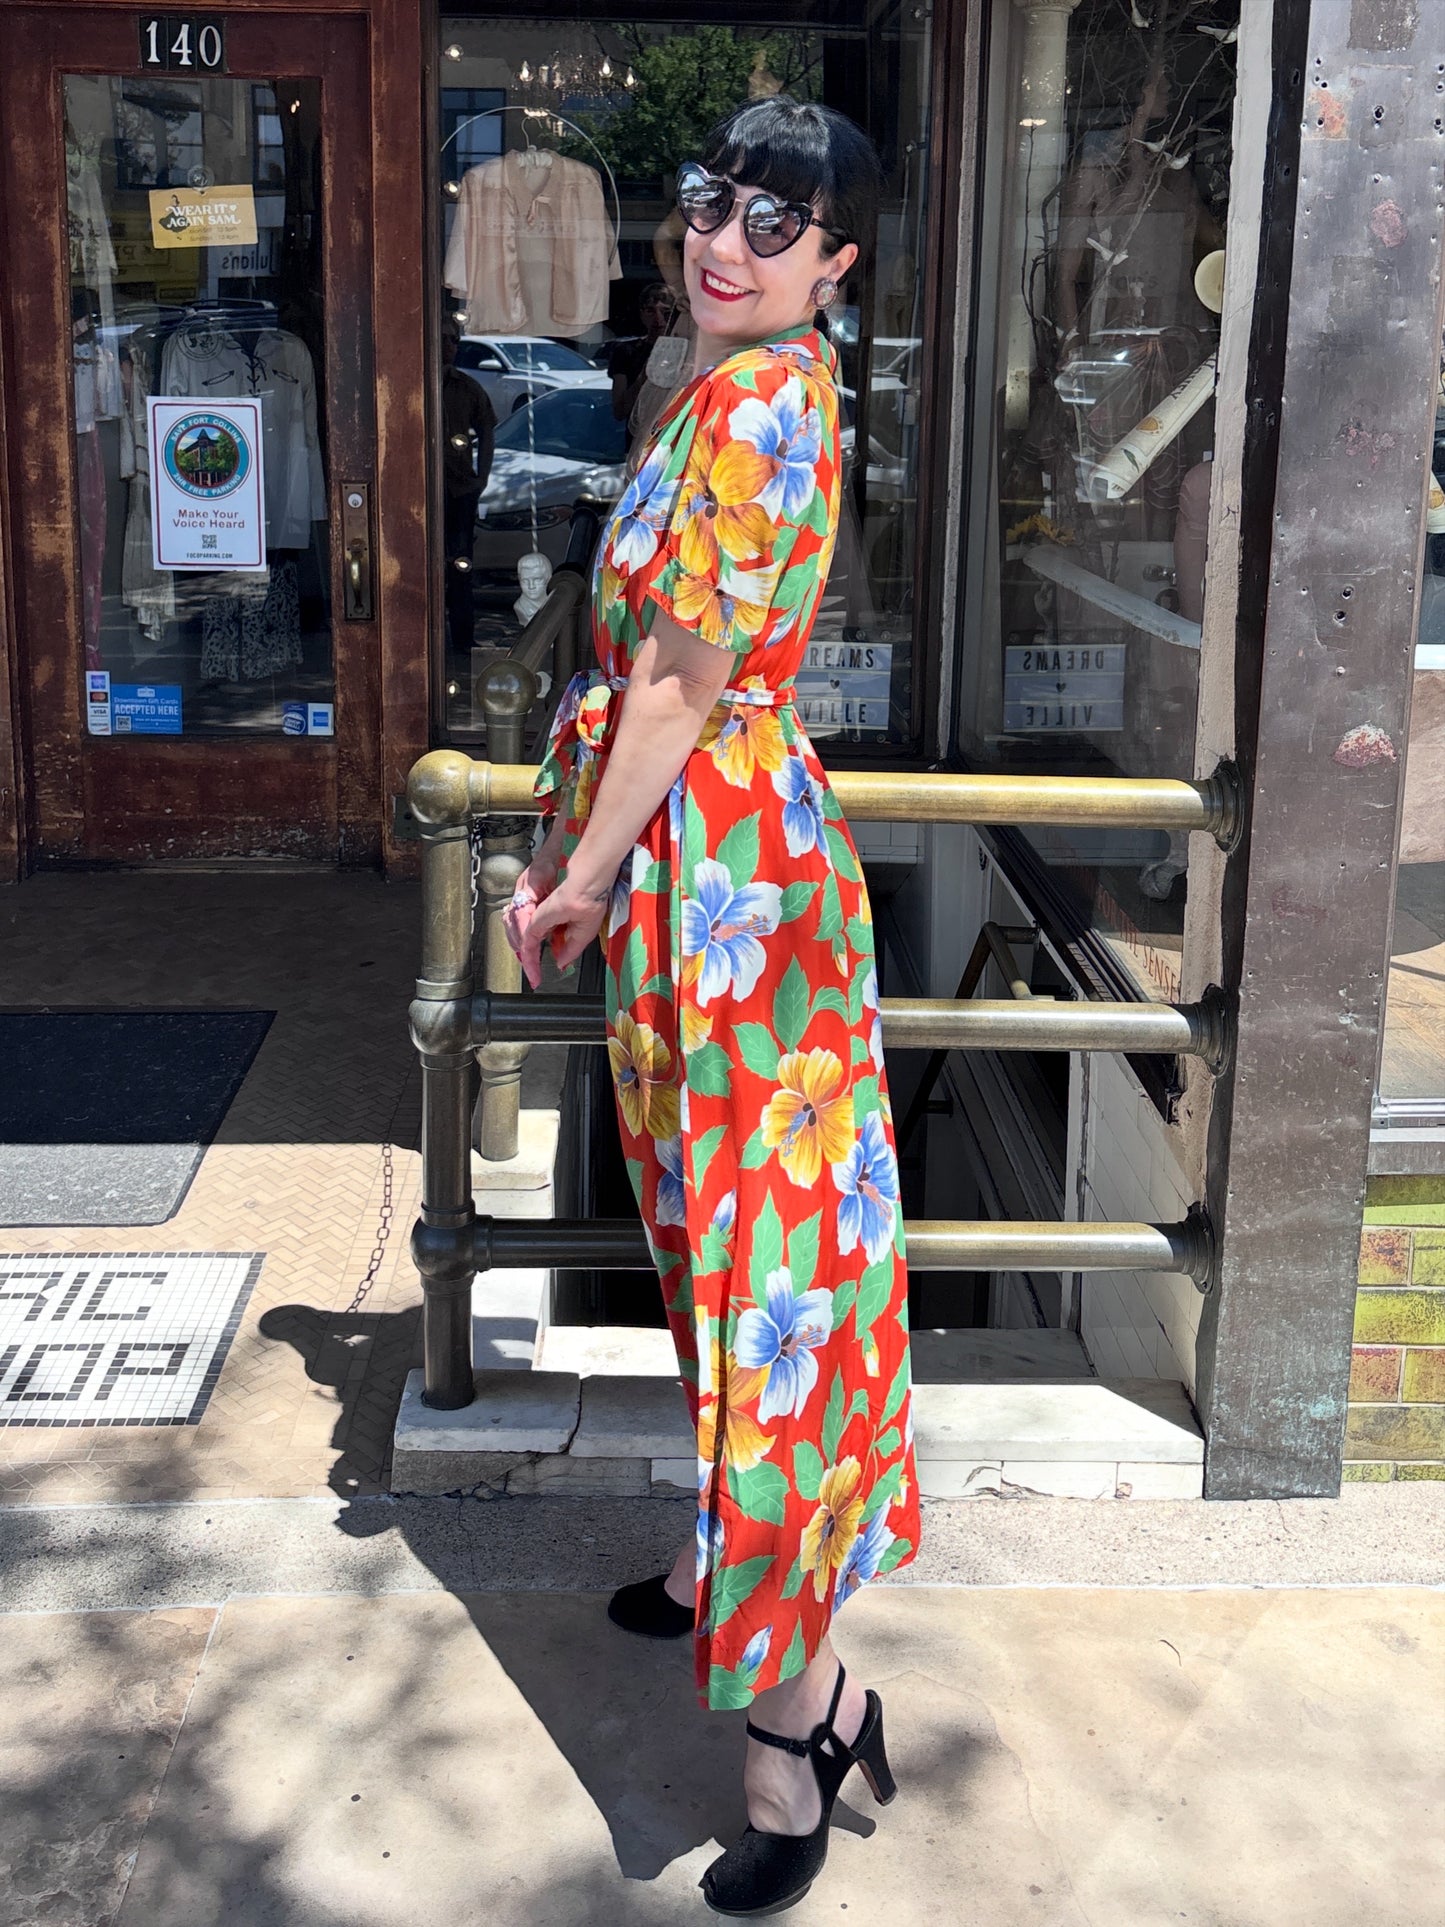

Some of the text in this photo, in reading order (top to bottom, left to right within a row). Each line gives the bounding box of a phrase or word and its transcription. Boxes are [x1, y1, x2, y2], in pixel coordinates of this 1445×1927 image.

[146, 21, 222, 67] 140
[165, 203, 228, 217] WEAR IT
[166, 214, 242, 228] AGAIN SAM
[188, 417, 209, 426] FORT
[188, 485, 209, 497] FREE
[212, 474, 241, 496] PARKING
[178, 509, 239, 519] Make Your
[172, 519, 245, 529] Voice Heard
[801, 647, 875, 668] REAMS
[114, 704, 179, 716] ACCEPTED HERE
[803, 702, 867, 723] VILLE
[0, 1343, 191, 1401] OP
